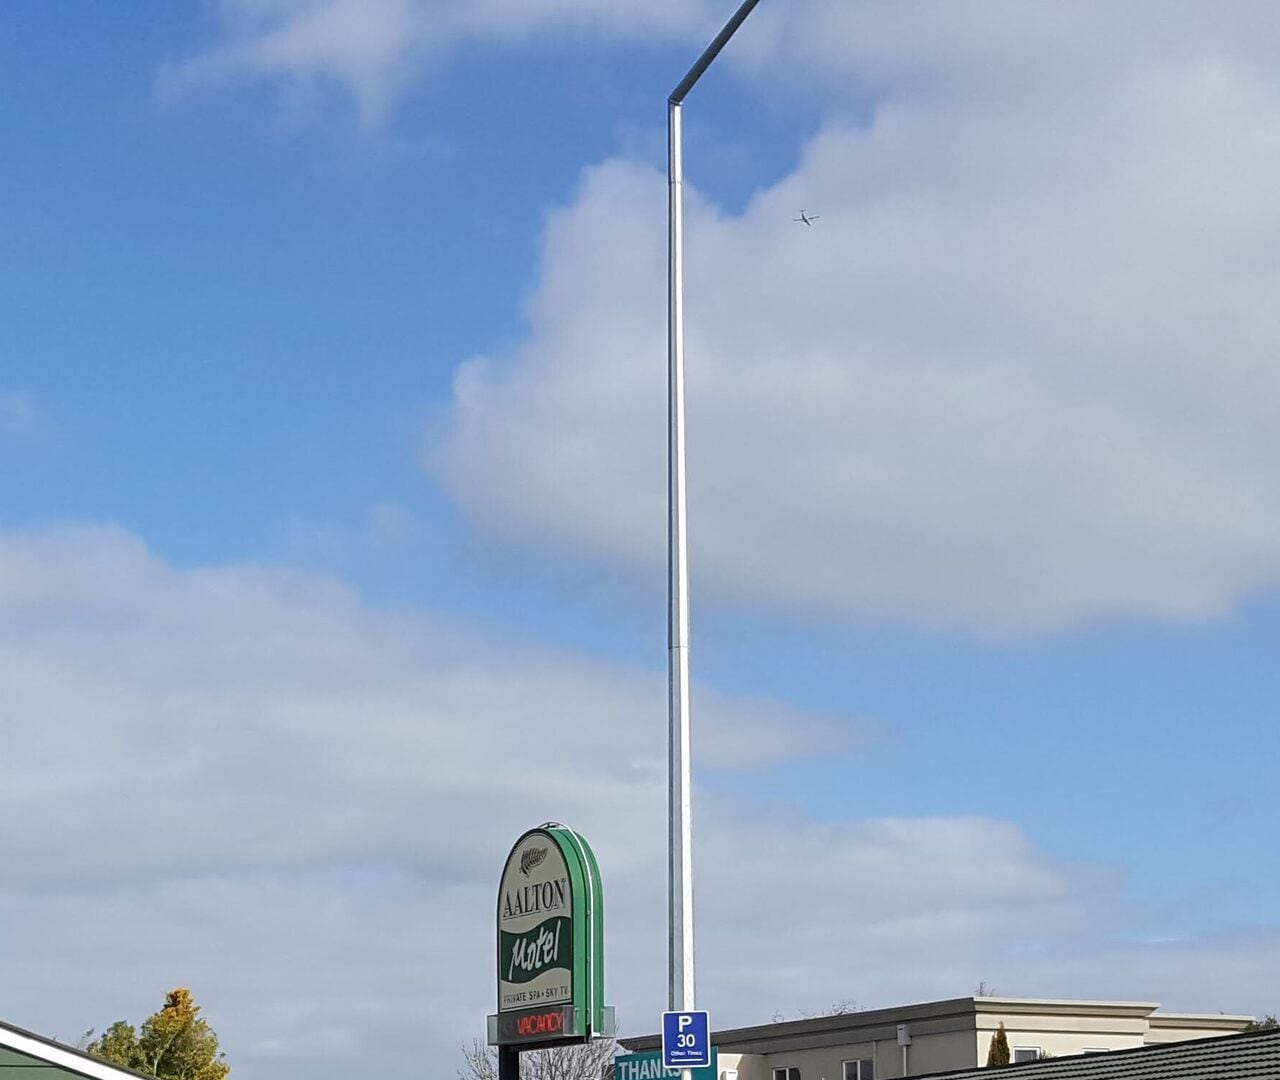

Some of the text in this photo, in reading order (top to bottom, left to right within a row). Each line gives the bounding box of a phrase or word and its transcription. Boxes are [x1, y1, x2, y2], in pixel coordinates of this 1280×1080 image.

[503, 880, 565, 918] AALTON
[508, 919, 561, 981] Motel
[503, 992, 526, 1004] PRIVATE
[529, 990, 540, 1000] SPA
[679, 1016, 692, 1032] P
[677, 1034, 695, 1047] 30
